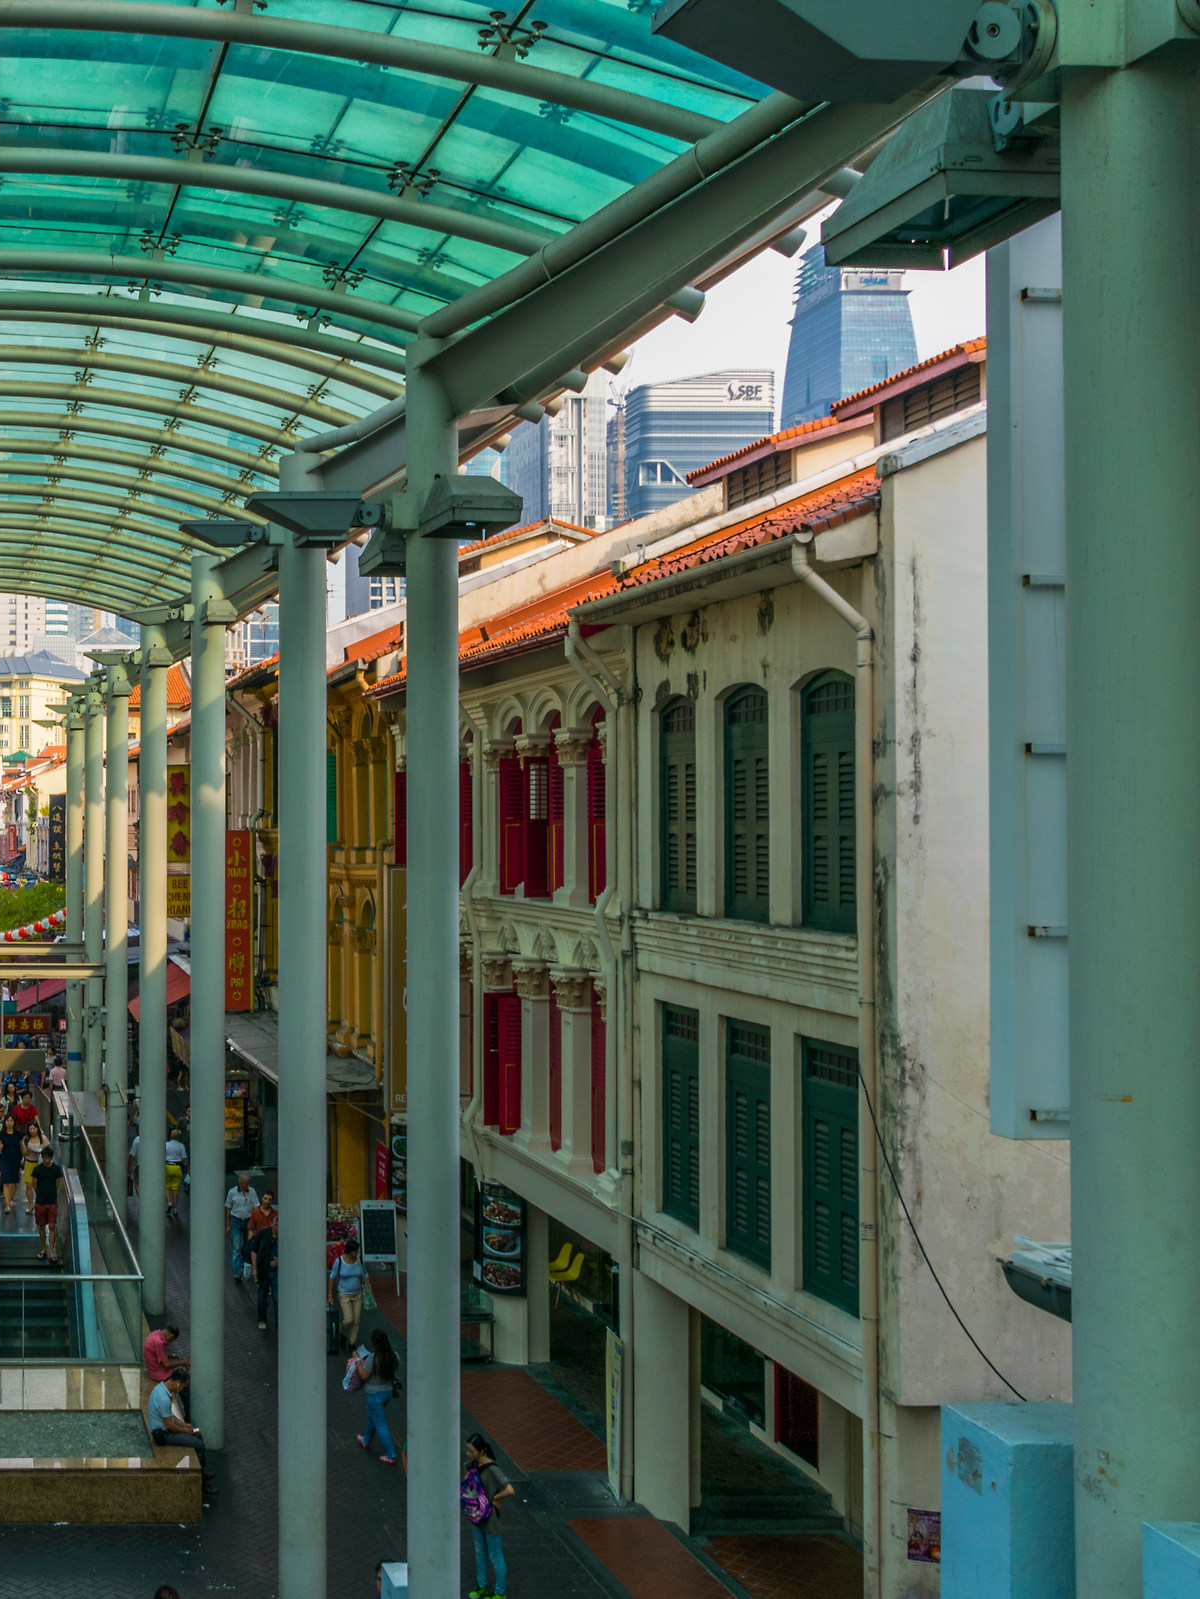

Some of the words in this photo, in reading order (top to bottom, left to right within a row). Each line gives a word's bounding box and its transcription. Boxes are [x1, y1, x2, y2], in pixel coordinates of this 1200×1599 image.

[738, 385, 762, 397] SBF
[172, 880, 188, 888] BEE
[230, 977, 244, 987] PAI
